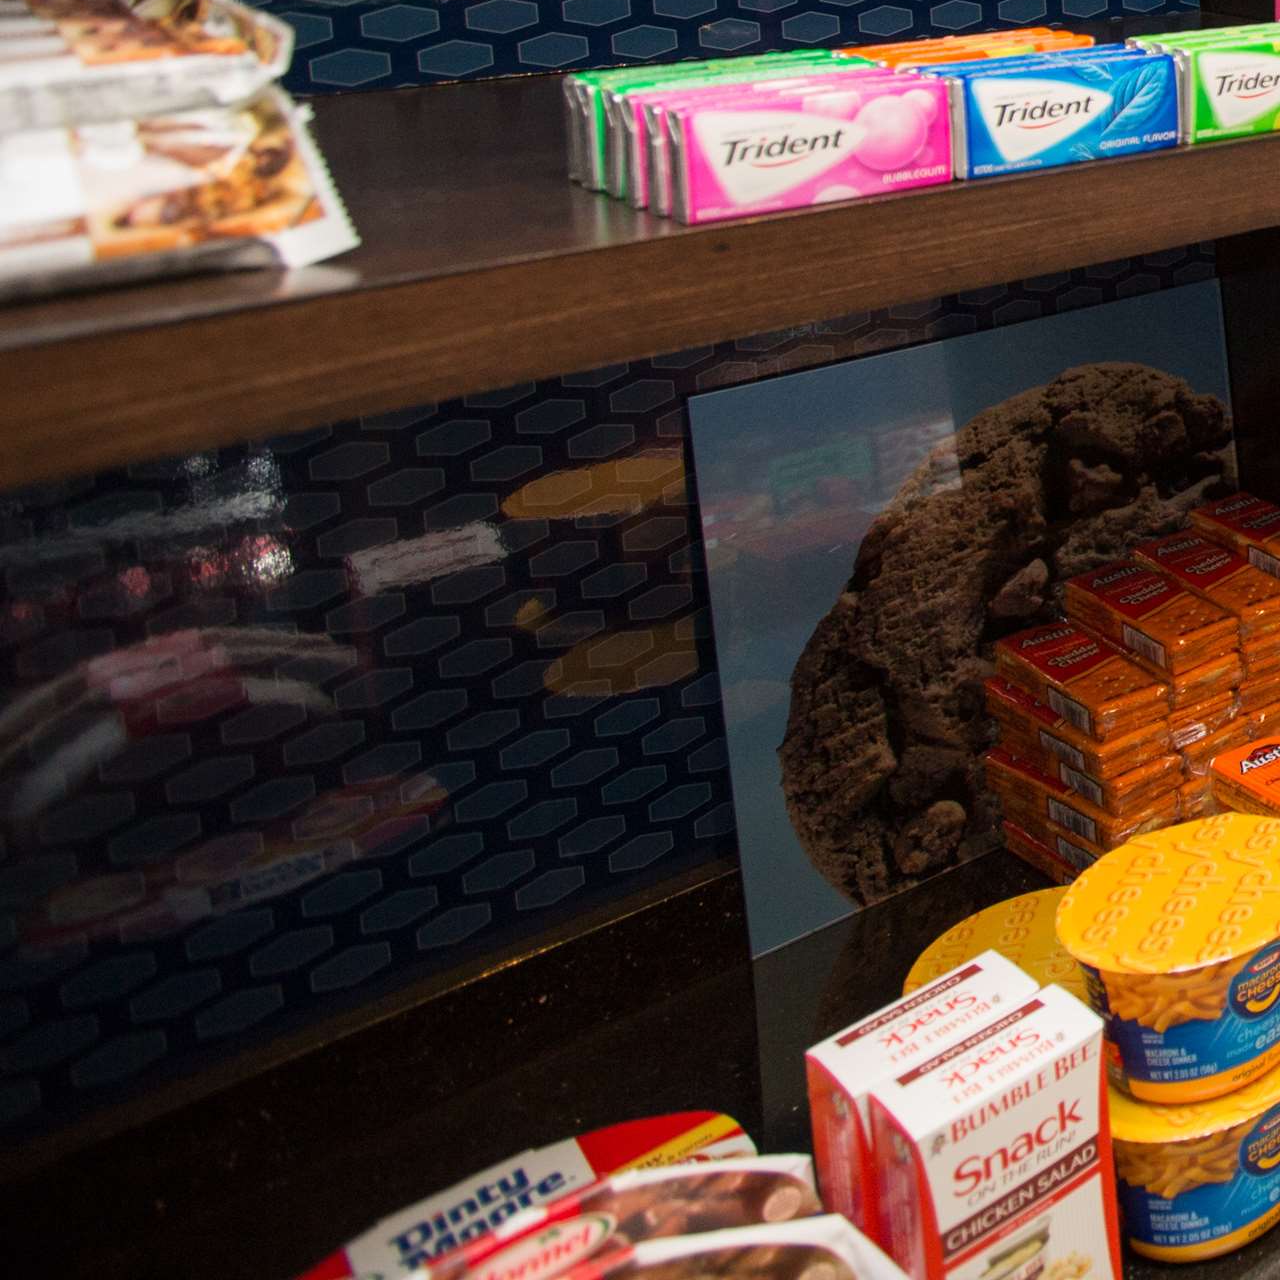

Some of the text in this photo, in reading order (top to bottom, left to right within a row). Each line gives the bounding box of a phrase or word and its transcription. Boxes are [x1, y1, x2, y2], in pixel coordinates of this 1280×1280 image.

[994, 95, 1095, 128] Trident
[720, 127, 846, 167] Trident
[1099, 131, 1175, 151] ORIGINAL FLAVOR
[882, 165, 946, 184] BUBBLEGUM
[1156, 537, 1207, 558] Austin
[1092, 566, 1144, 589] Austin
[1020, 627, 1076, 649] Austin
[858, 975, 960, 1038] CHICKEN SALAD
[880, 992, 977, 1047] Snack
[919, 1010, 1024, 1074] CHICKEN SALAD
[943, 1029, 1040, 1083] Snack
[950, 1043, 1093, 1145] BUMBLE BEE
[953, 1098, 1083, 1198] Snack
[388, 1167, 529, 1255] Dinty
[947, 1187, 1035, 1252] CHICKEN
[1037, 1143, 1097, 1193] SALAD
[967, 1184, 997, 1208] ON
[1000, 1161, 1034, 1195] THE
[401, 1170, 567, 1270] Moore
